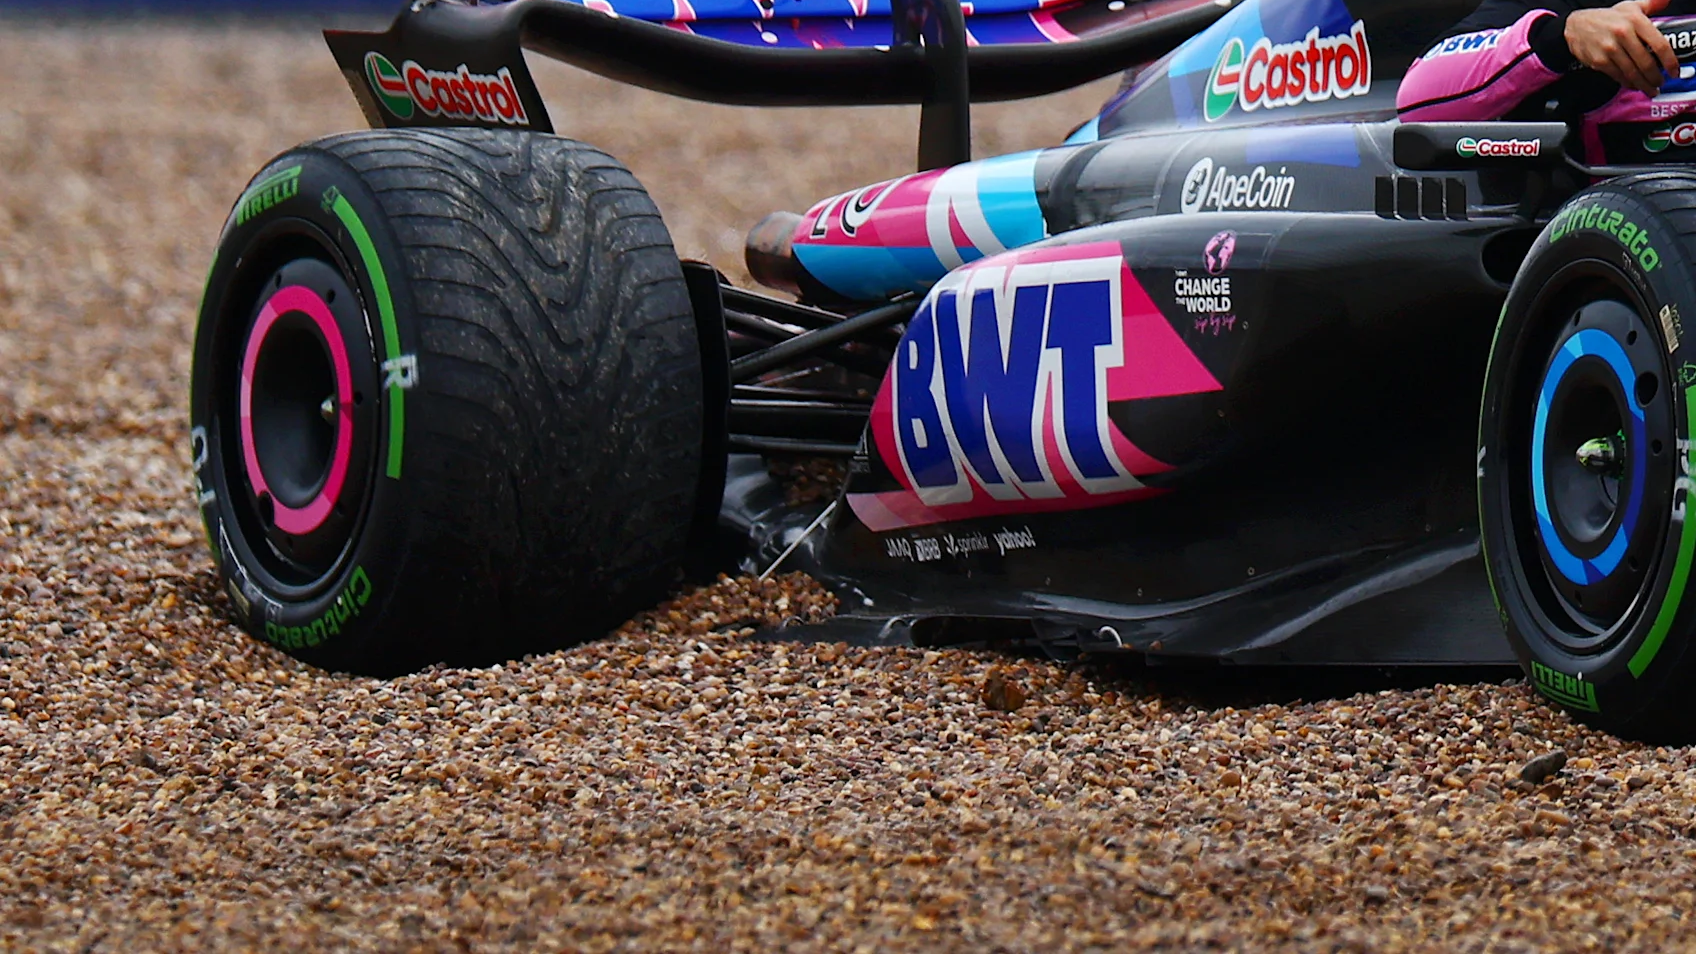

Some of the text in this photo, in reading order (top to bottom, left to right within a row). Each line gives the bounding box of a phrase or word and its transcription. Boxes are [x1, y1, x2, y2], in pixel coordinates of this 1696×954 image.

[1241, 24, 1369, 107] Castrol
[404, 62, 527, 123] Castrol
[1478, 139, 1540, 157] Castrol
[236, 164, 302, 226] PIRELLI
[1207, 167, 1295, 211] ApeCoin
[1175, 278, 1231, 296] CHANGE
[1186, 296, 1231, 313] WORLD
[896, 268, 1118, 496] BWT
[993, 525, 1037, 557] yahoo!
[1530, 659, 1601, 713] PIRELLI
